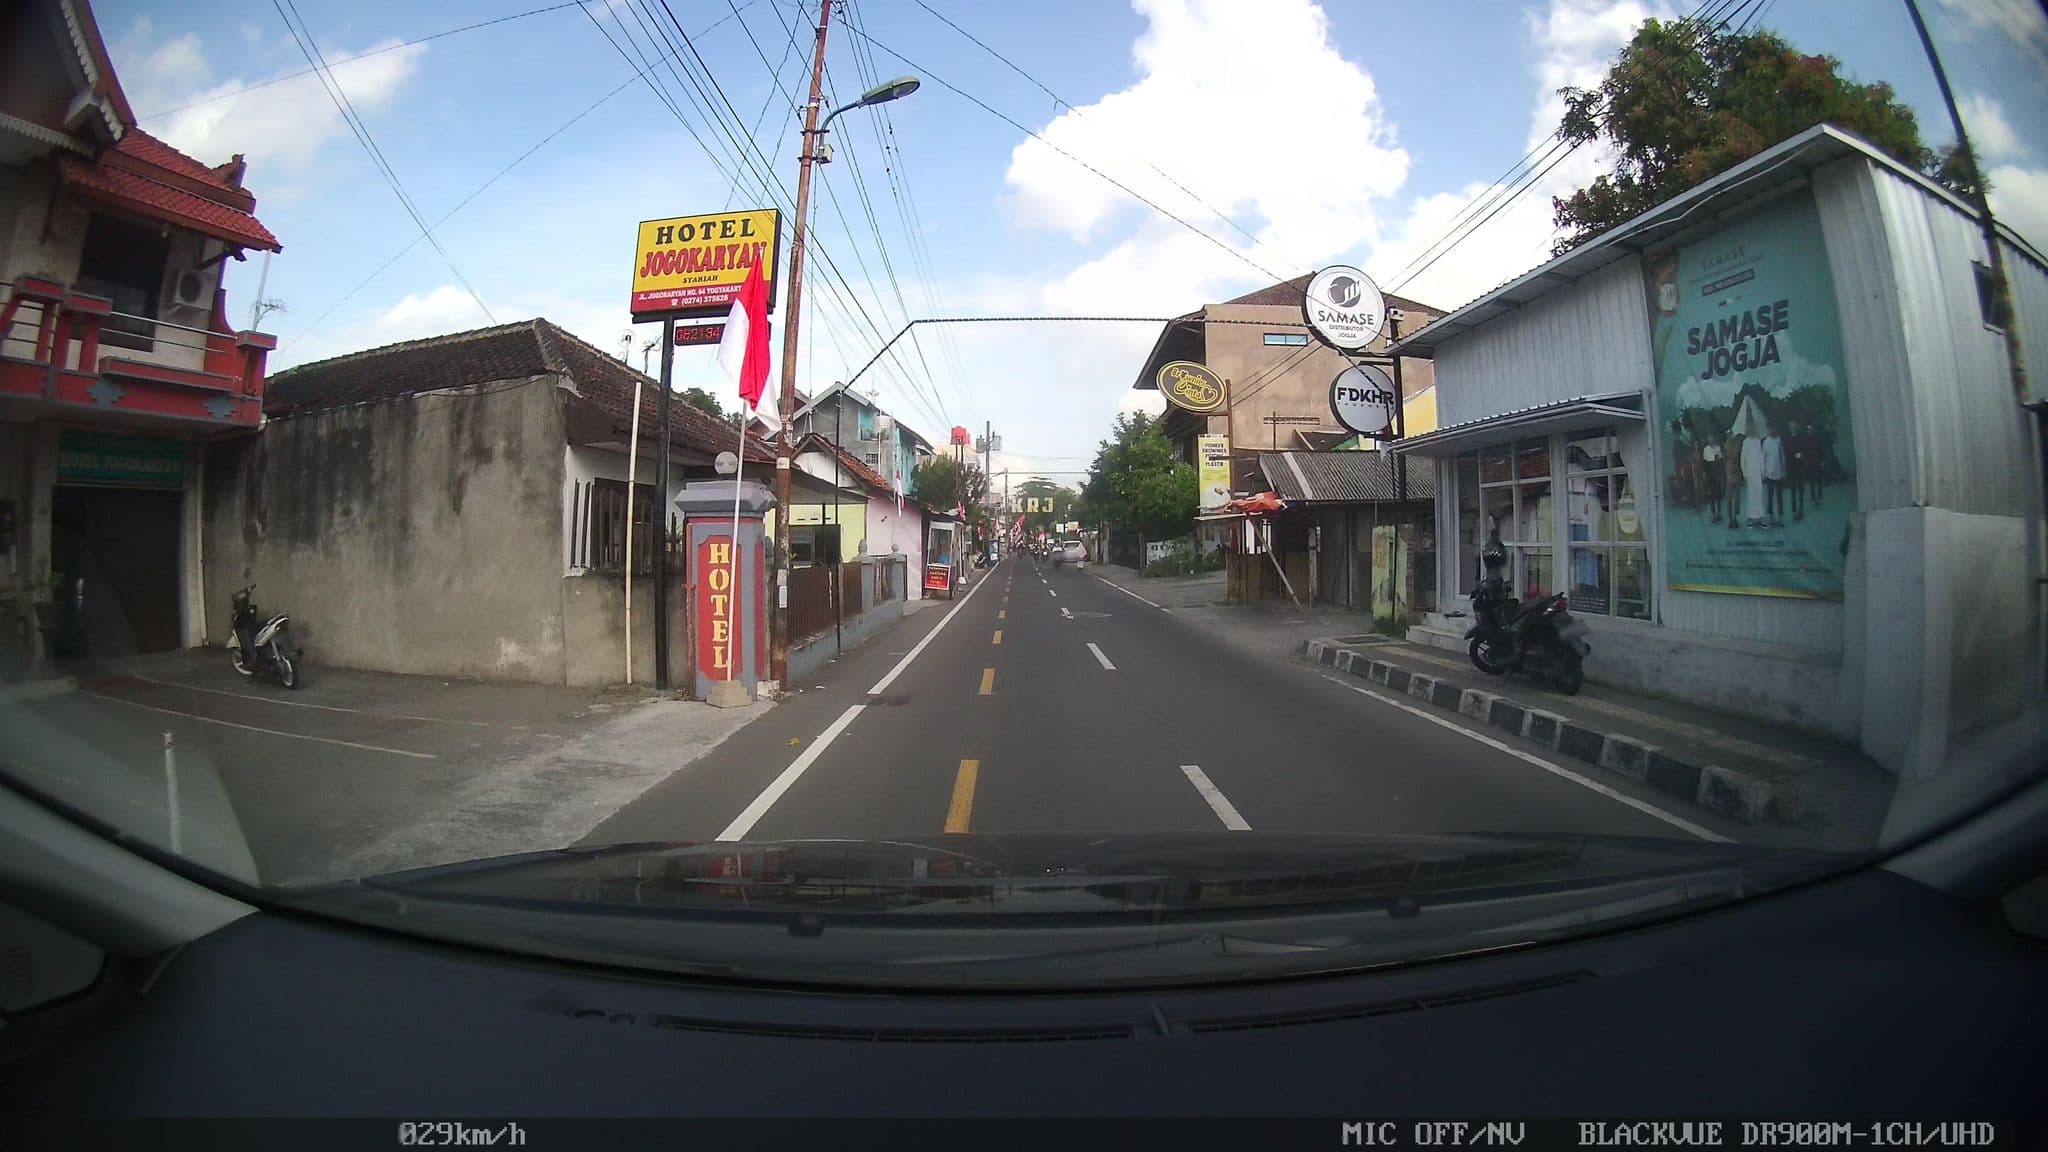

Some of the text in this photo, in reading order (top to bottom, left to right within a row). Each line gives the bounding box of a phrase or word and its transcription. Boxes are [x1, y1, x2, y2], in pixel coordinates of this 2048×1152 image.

[655, 218, 755, 245] HOTEL
[640, 241, 767, 278] JOGOKARYAN
[1318, 310, 1374, 325] SAMASE
[1686, 299, 1789, 355] SAMASE
[1701, 334, 1780, 380] JOGJA
[1337, 386, 1394, 405] FDKHR
[708, 543, 732, 669] HOTEL
